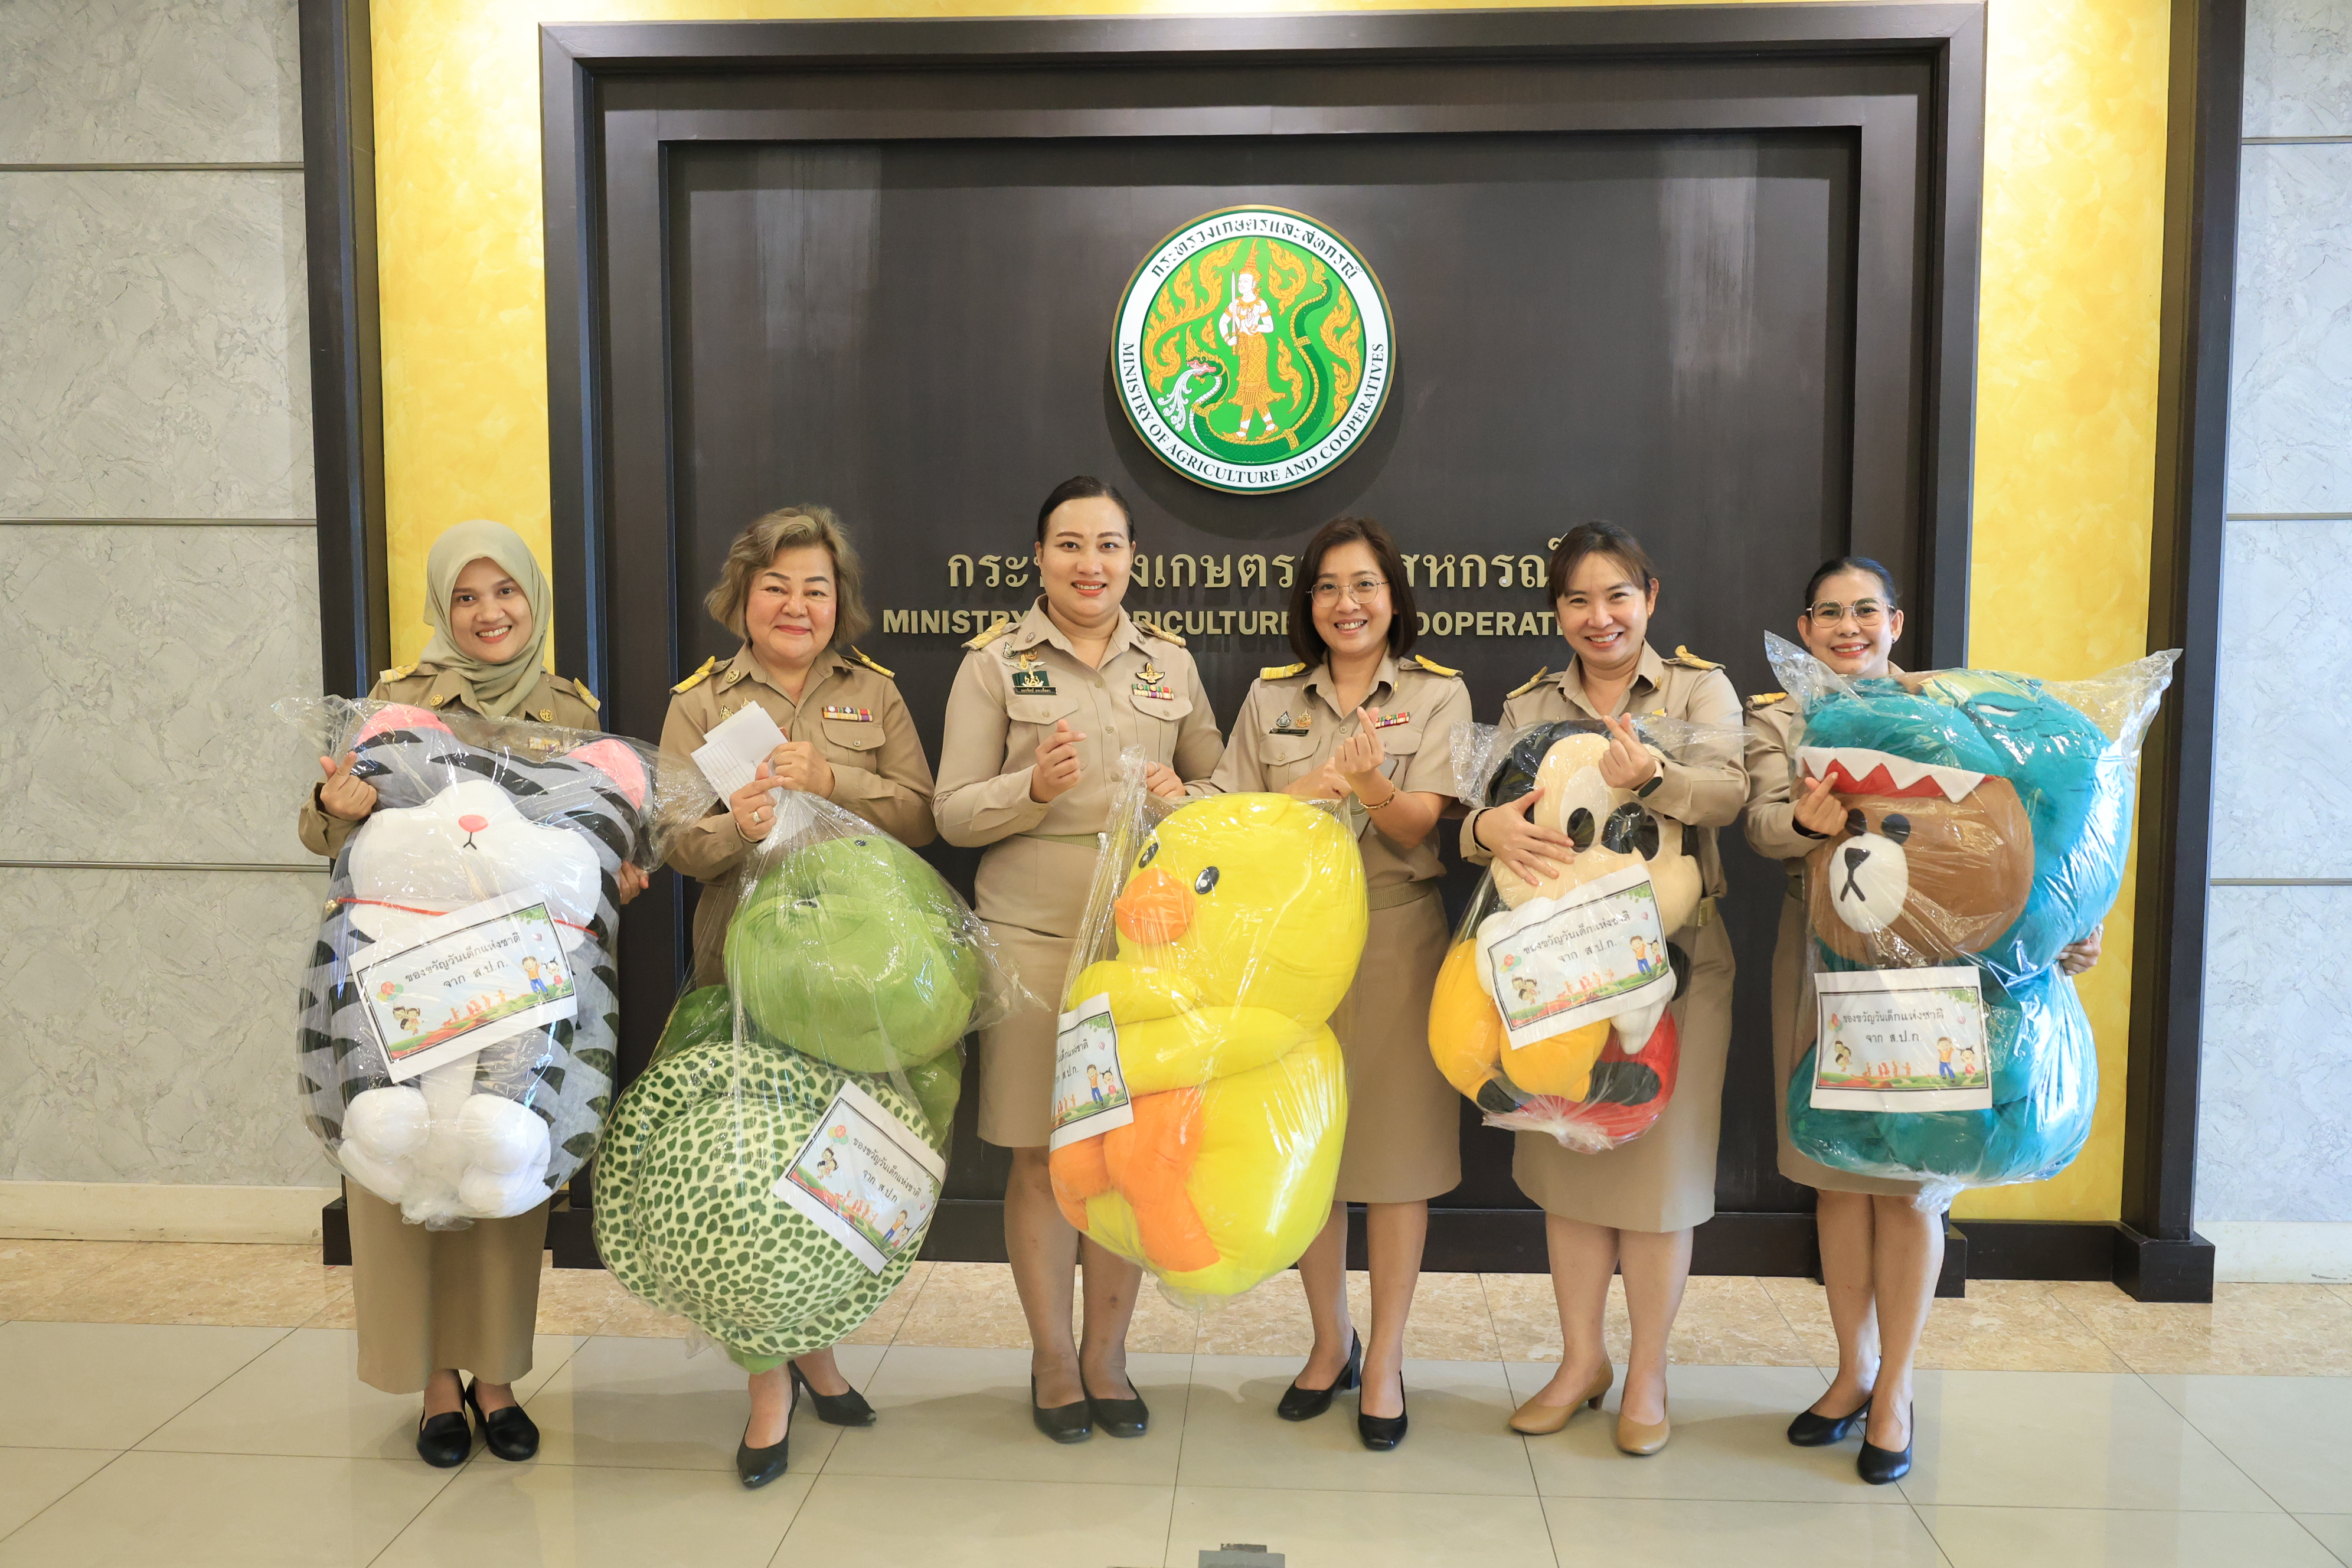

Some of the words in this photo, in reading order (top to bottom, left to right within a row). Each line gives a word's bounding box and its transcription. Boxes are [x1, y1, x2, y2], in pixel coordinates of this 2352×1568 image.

[1151, 218, 1363, 279] กระทรวงเกษตรและสหกรณ์
[1122, 342, 1155, 424] MINISTRY
[1149, 420, 1170, 445] OF
[1165, 443, 1280, 484] AGRICULTURE
[1285, 456, 1318, 479] AND
[1319, 343, 1384, 459] COOPERATIVES
[1524, 910, 1630, 954] ของขวัญวันเด็กแห่งชาติ
[405, 932, 521, 982] ของขวัญวันเด็กแห่งชาติ
[443, 973, 465, 988] จาก
[473, 958, 508, 979] ส.ป.ก.
[1558, 951, 1578, 963] จาก
[1843, 1008, 1944, 1024] ของขวัญวันเด็กแห่งชาติ
[1866, 1034, 1883, 1043] จาก
[854, 1137, 922, 1198] ของขวัญวันเด็กแห่งชาติ
[863, 1169, 876, 1185] จาก
